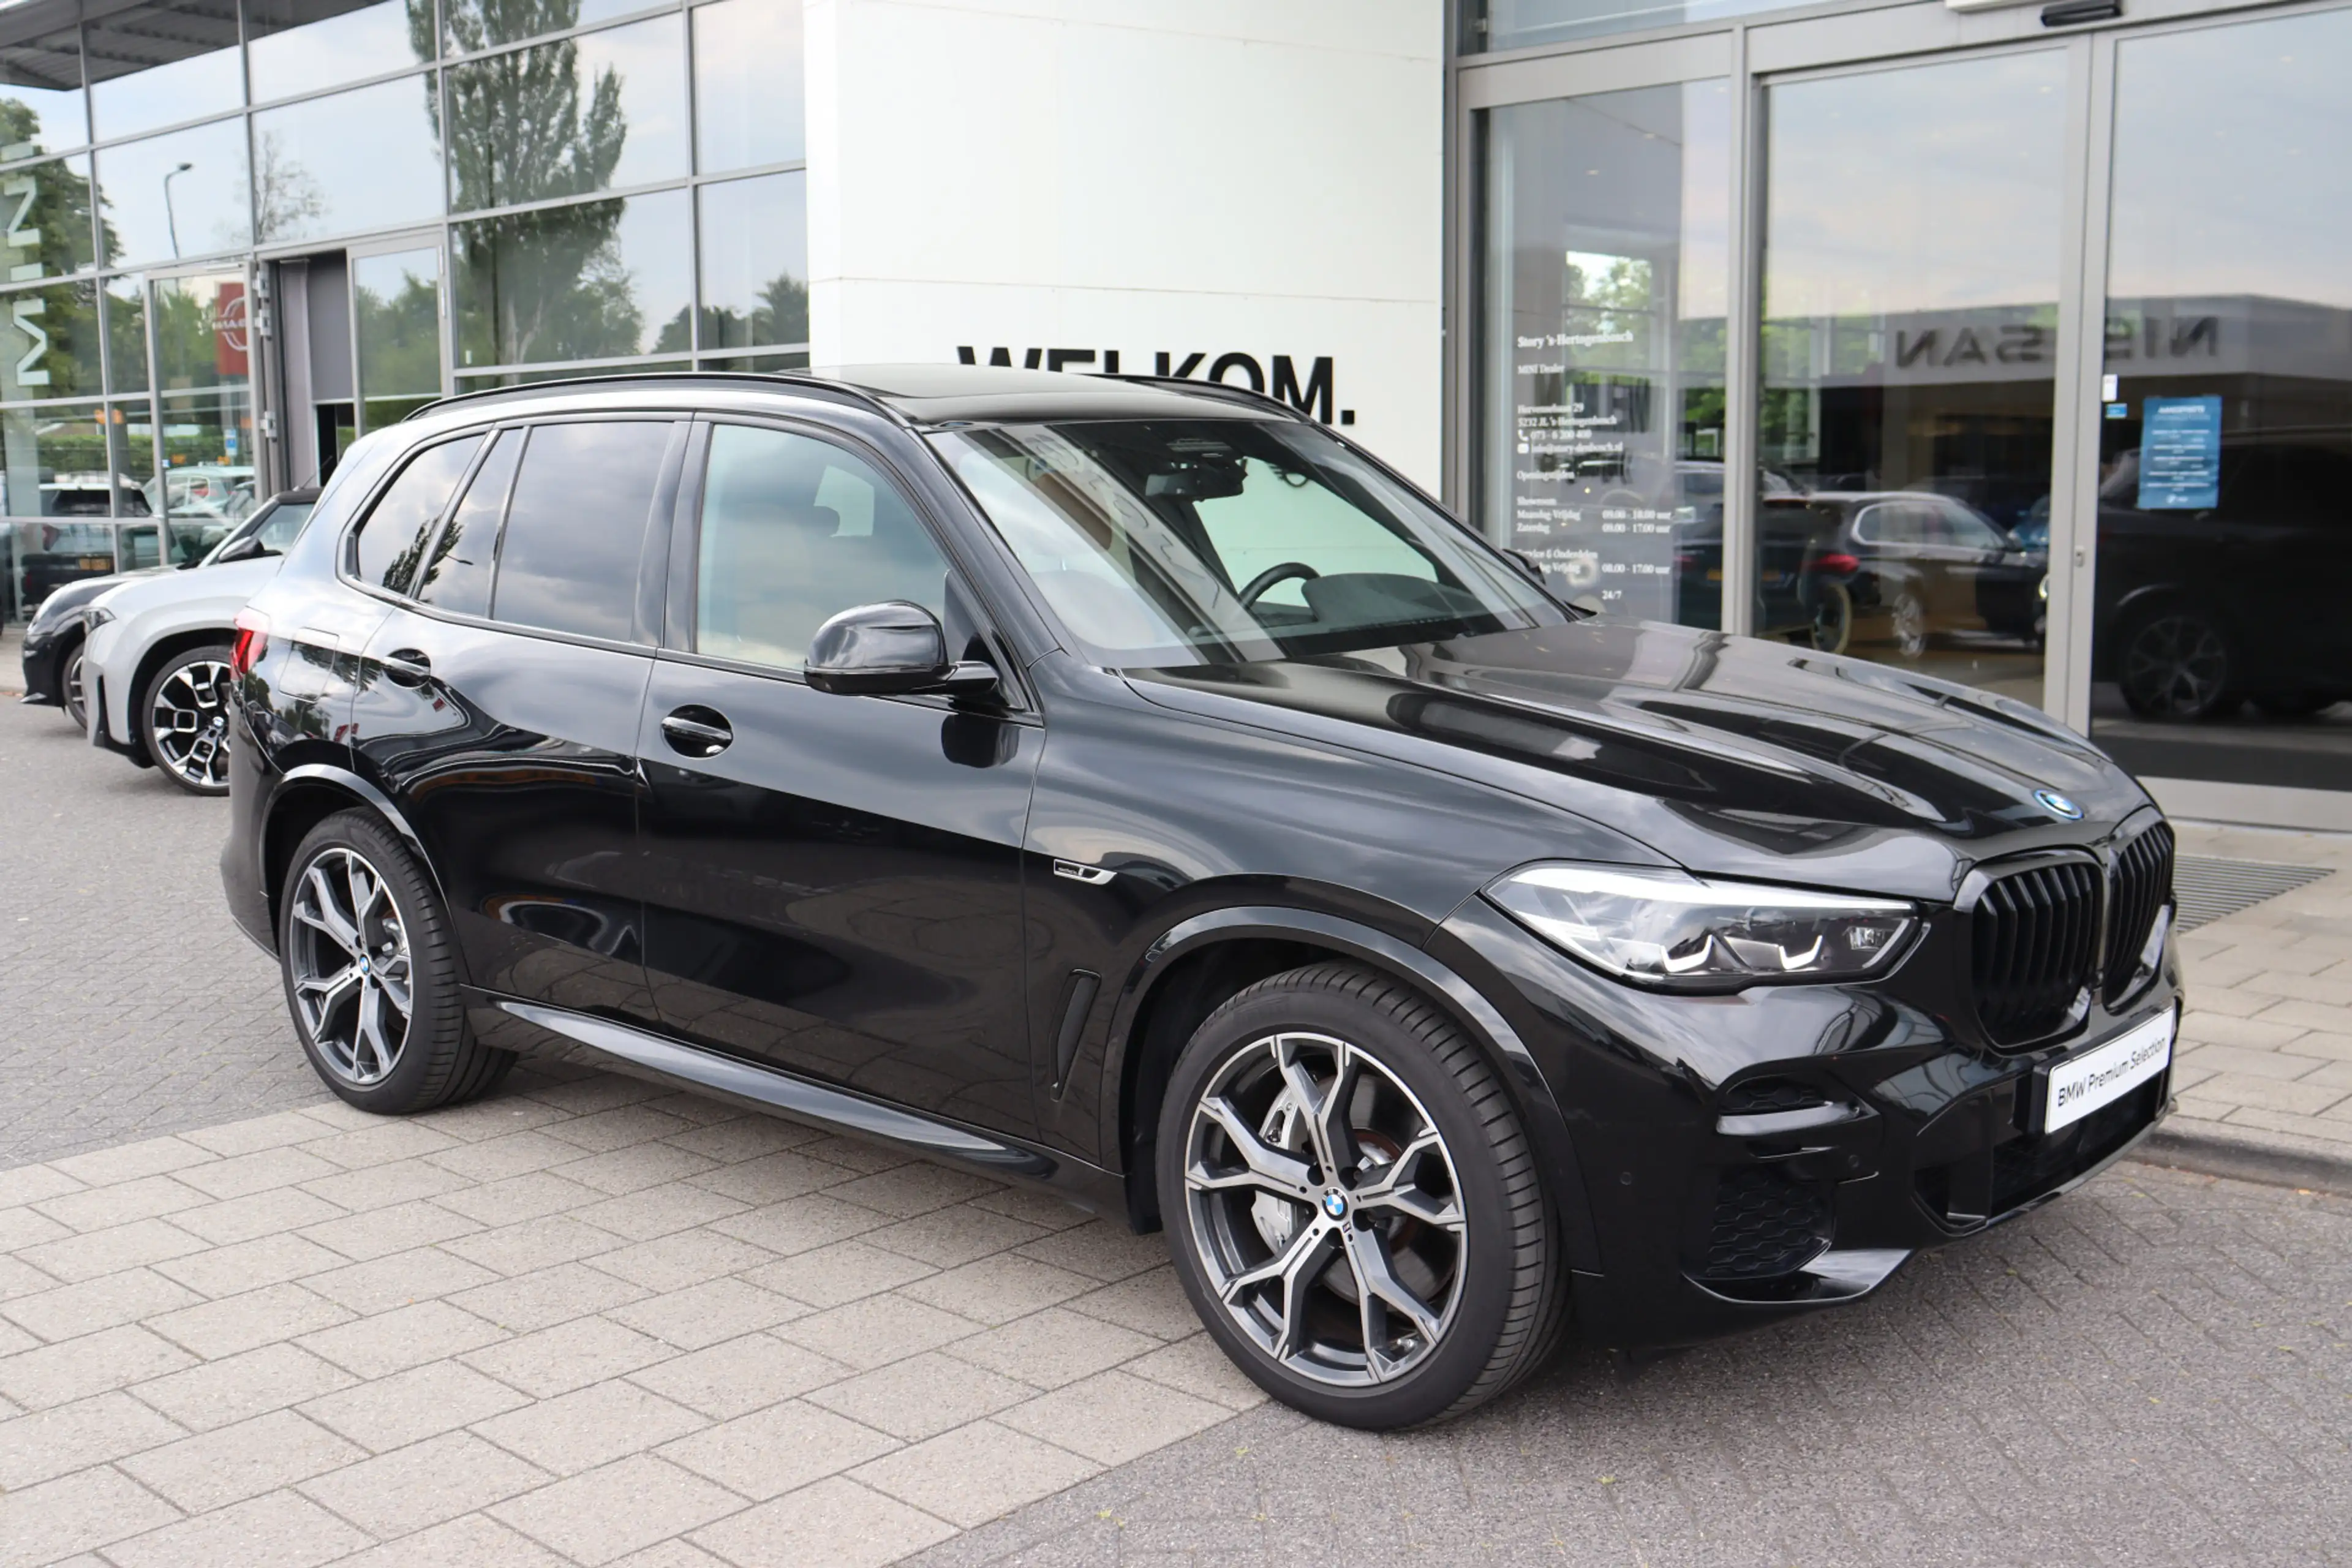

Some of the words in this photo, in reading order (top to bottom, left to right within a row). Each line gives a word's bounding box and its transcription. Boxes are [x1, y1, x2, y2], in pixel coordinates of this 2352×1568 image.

[2, 140, 50, 386] MINI
[1602, 590, 1623, 600] 24/7
[2057, 1077, 2087, 1108] BMW
[2087, 1060, 2129, 1093] Premium
[2130, 1037, 2166, 1069] Selection
